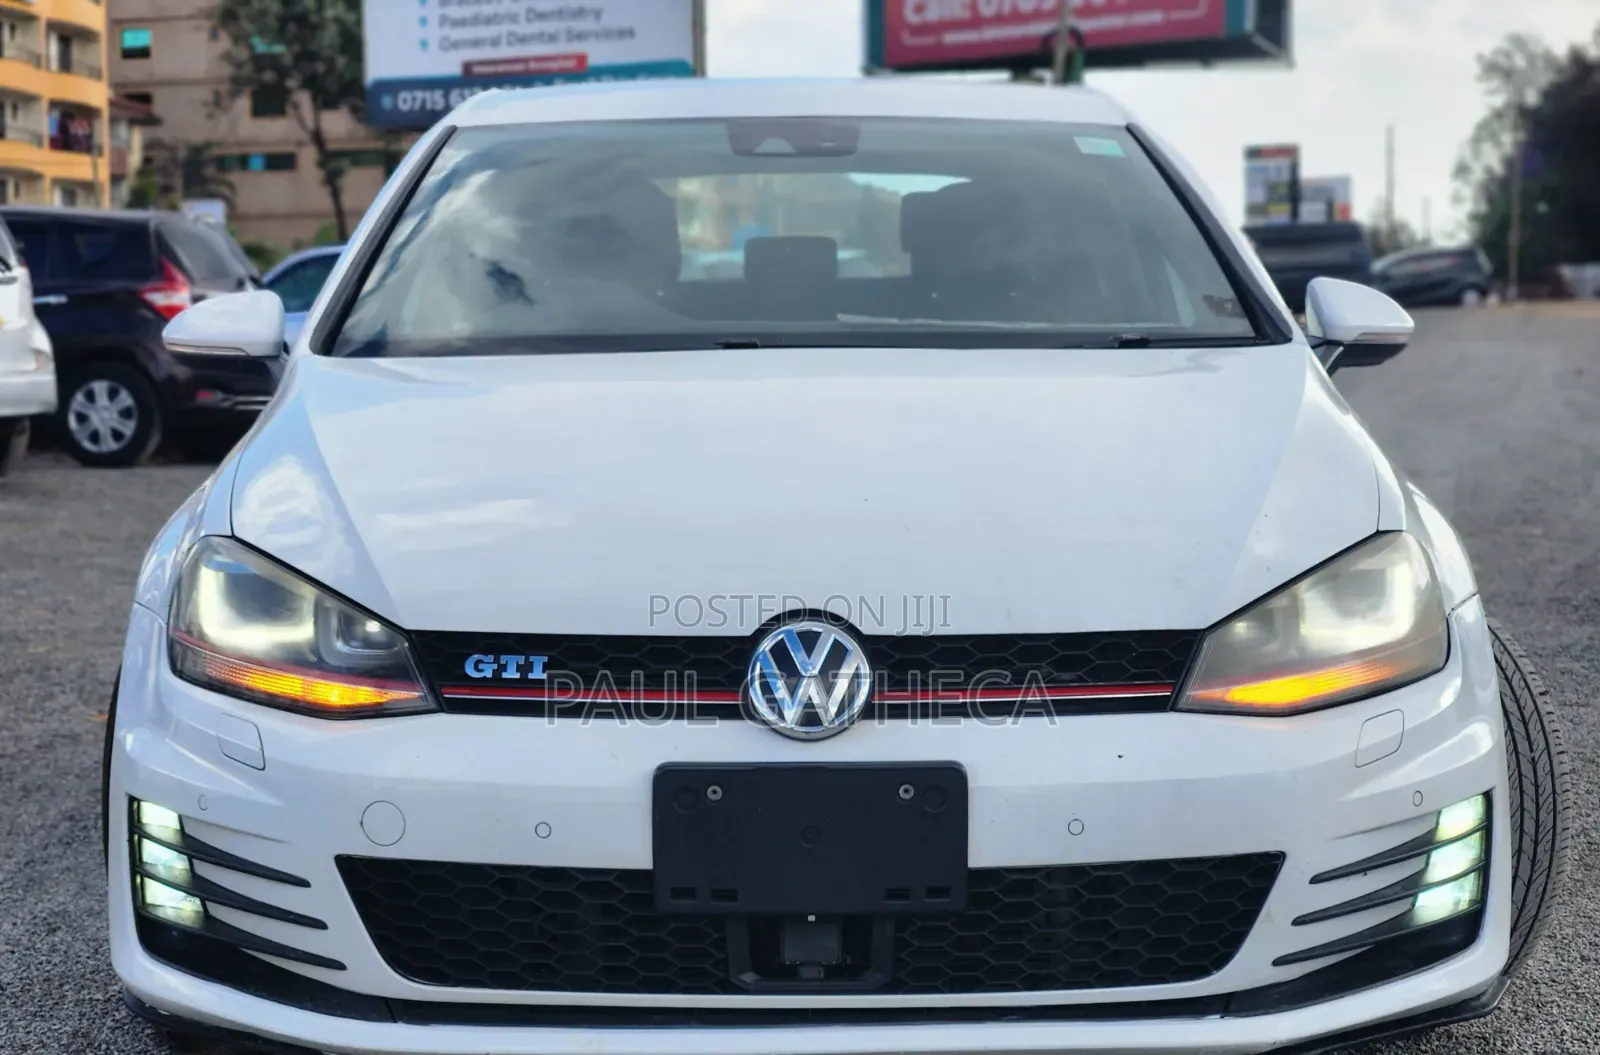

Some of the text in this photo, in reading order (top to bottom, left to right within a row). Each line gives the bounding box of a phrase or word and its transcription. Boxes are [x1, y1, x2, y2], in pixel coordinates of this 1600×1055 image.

[438, 6, 604, 29] Paediatric Dentistry
[438, 26, 636, 52] General Dental Services
[397, 89, 446, 112] 0715
[464, 653, 549, 680] GTI
